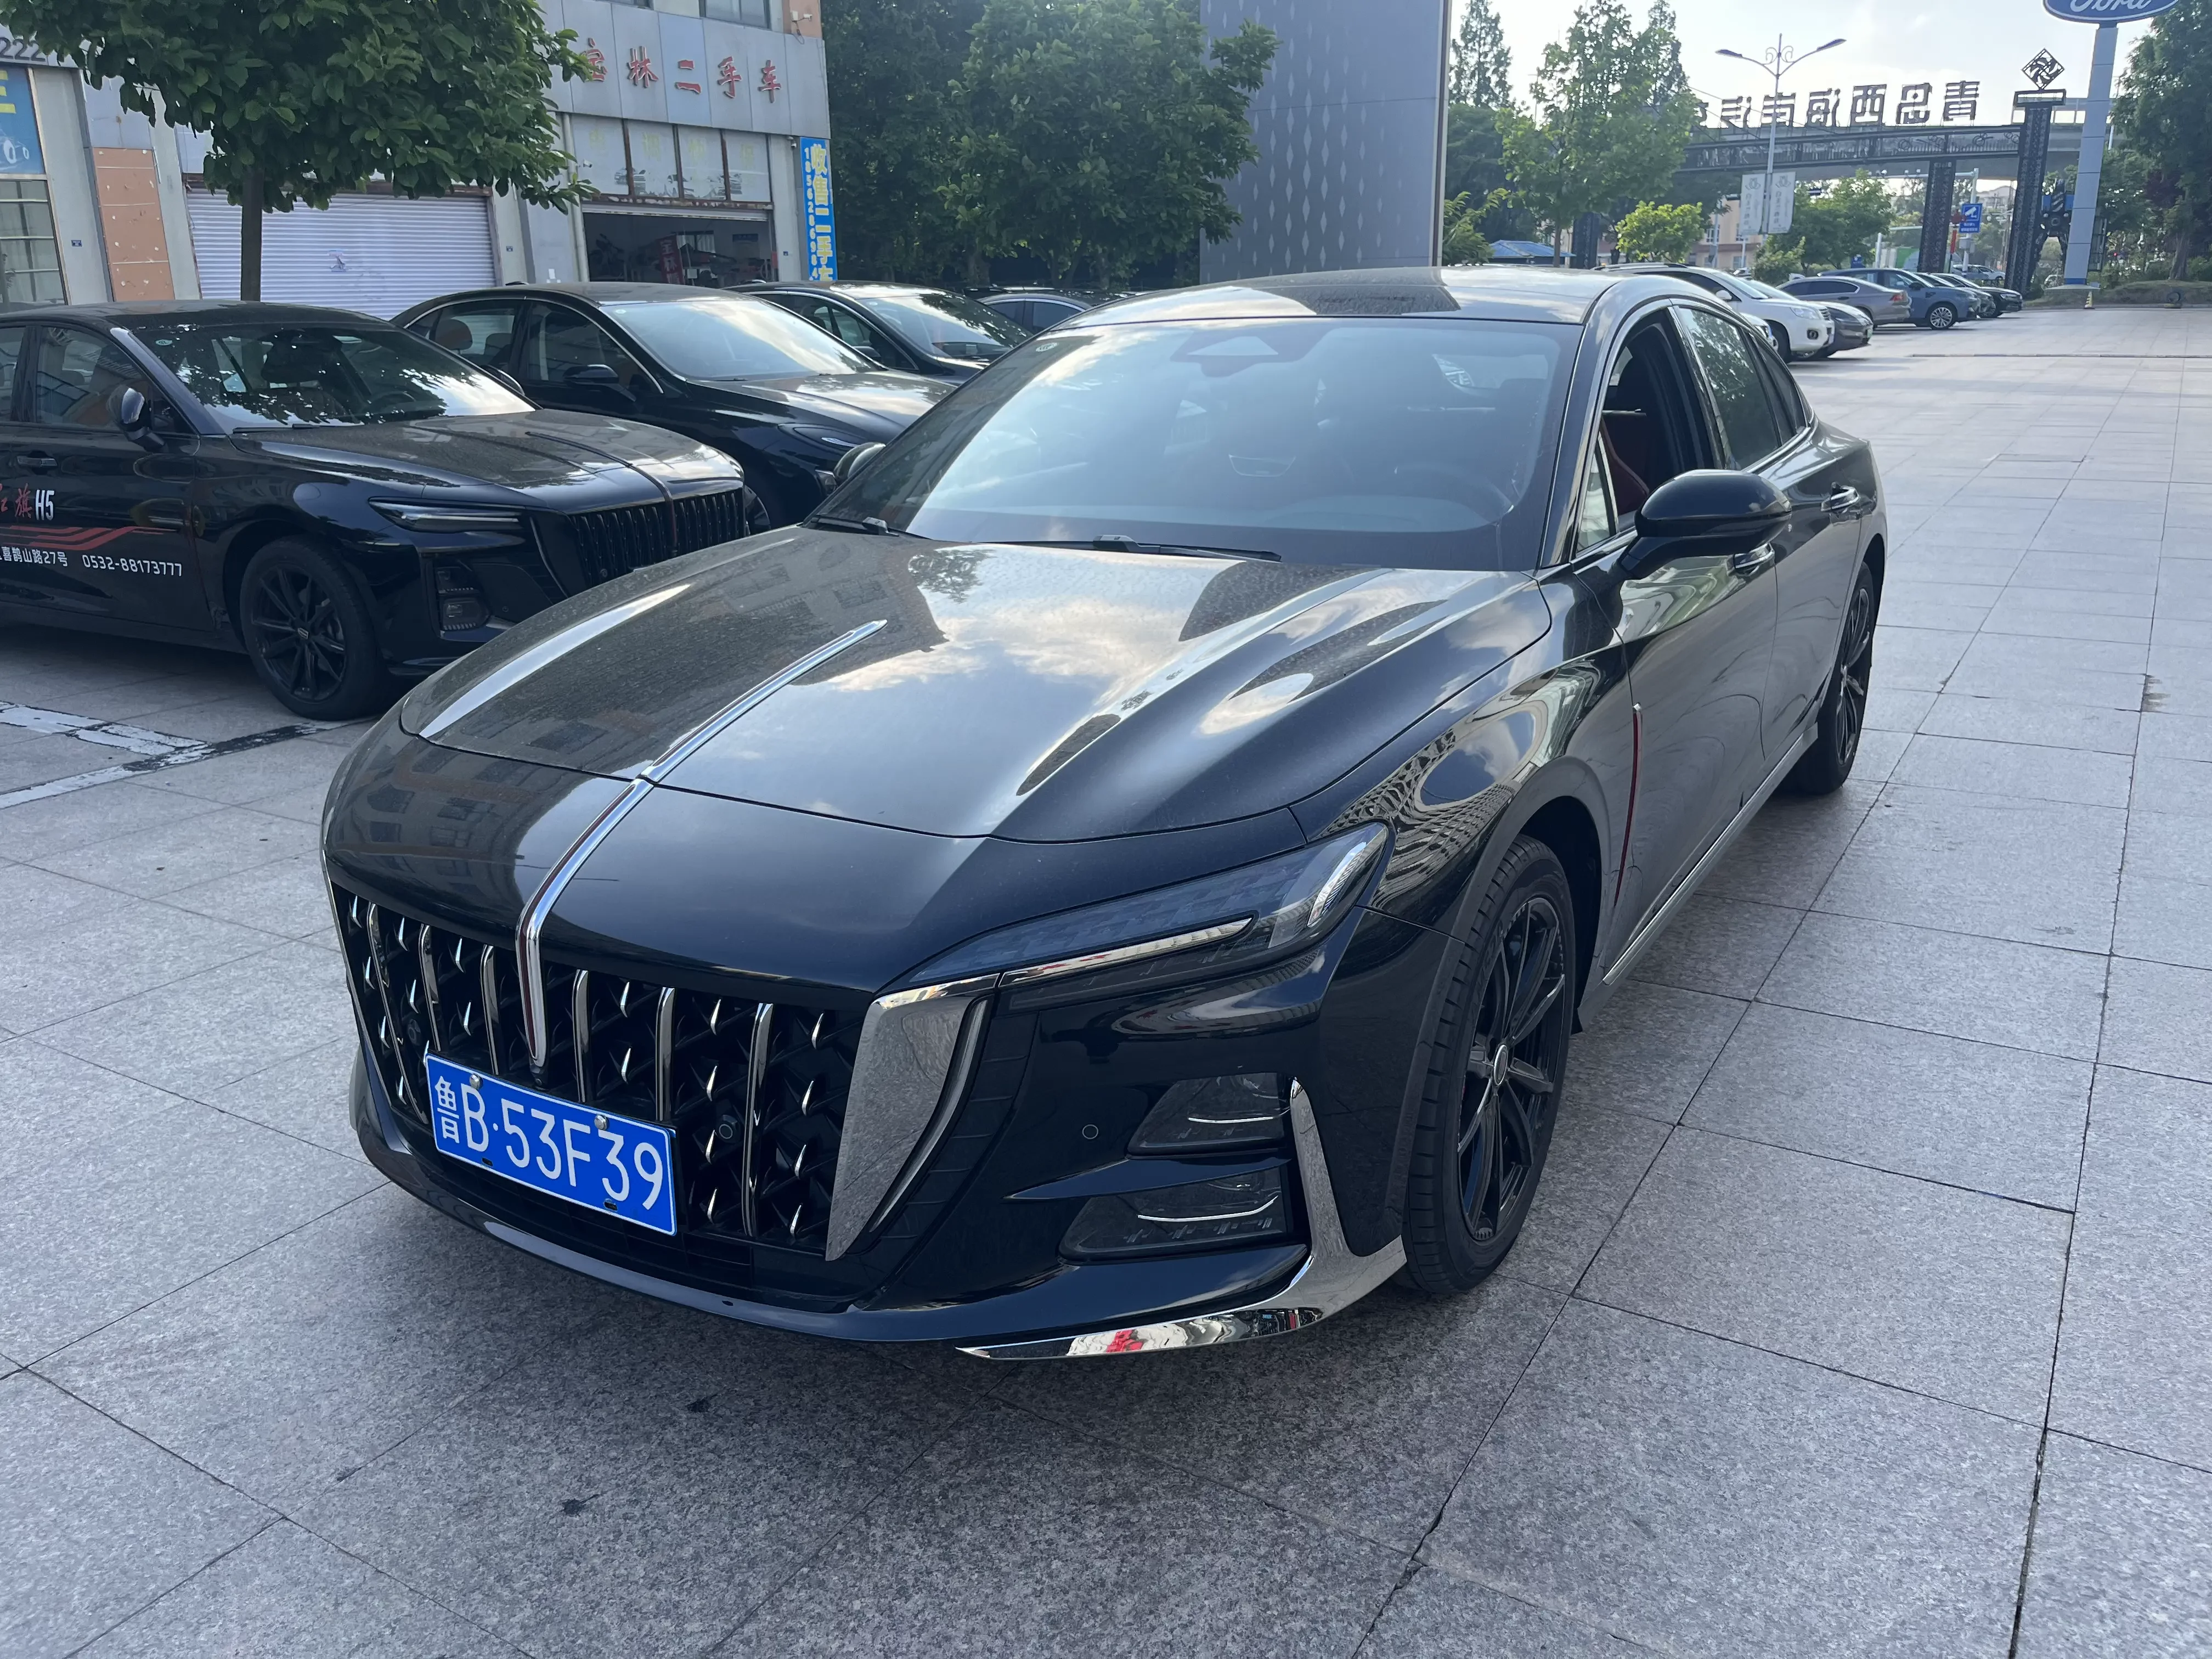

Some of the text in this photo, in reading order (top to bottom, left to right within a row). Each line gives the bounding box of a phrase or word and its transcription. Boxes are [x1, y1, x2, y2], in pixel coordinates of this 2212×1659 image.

[580, 37, 781, 103] 宝林二手车
[35, 489, 54, 520] H5
[0, 546, 68, 567] 喜鹊山路27号
[82, 555, 182, 576] 0532-88173777
